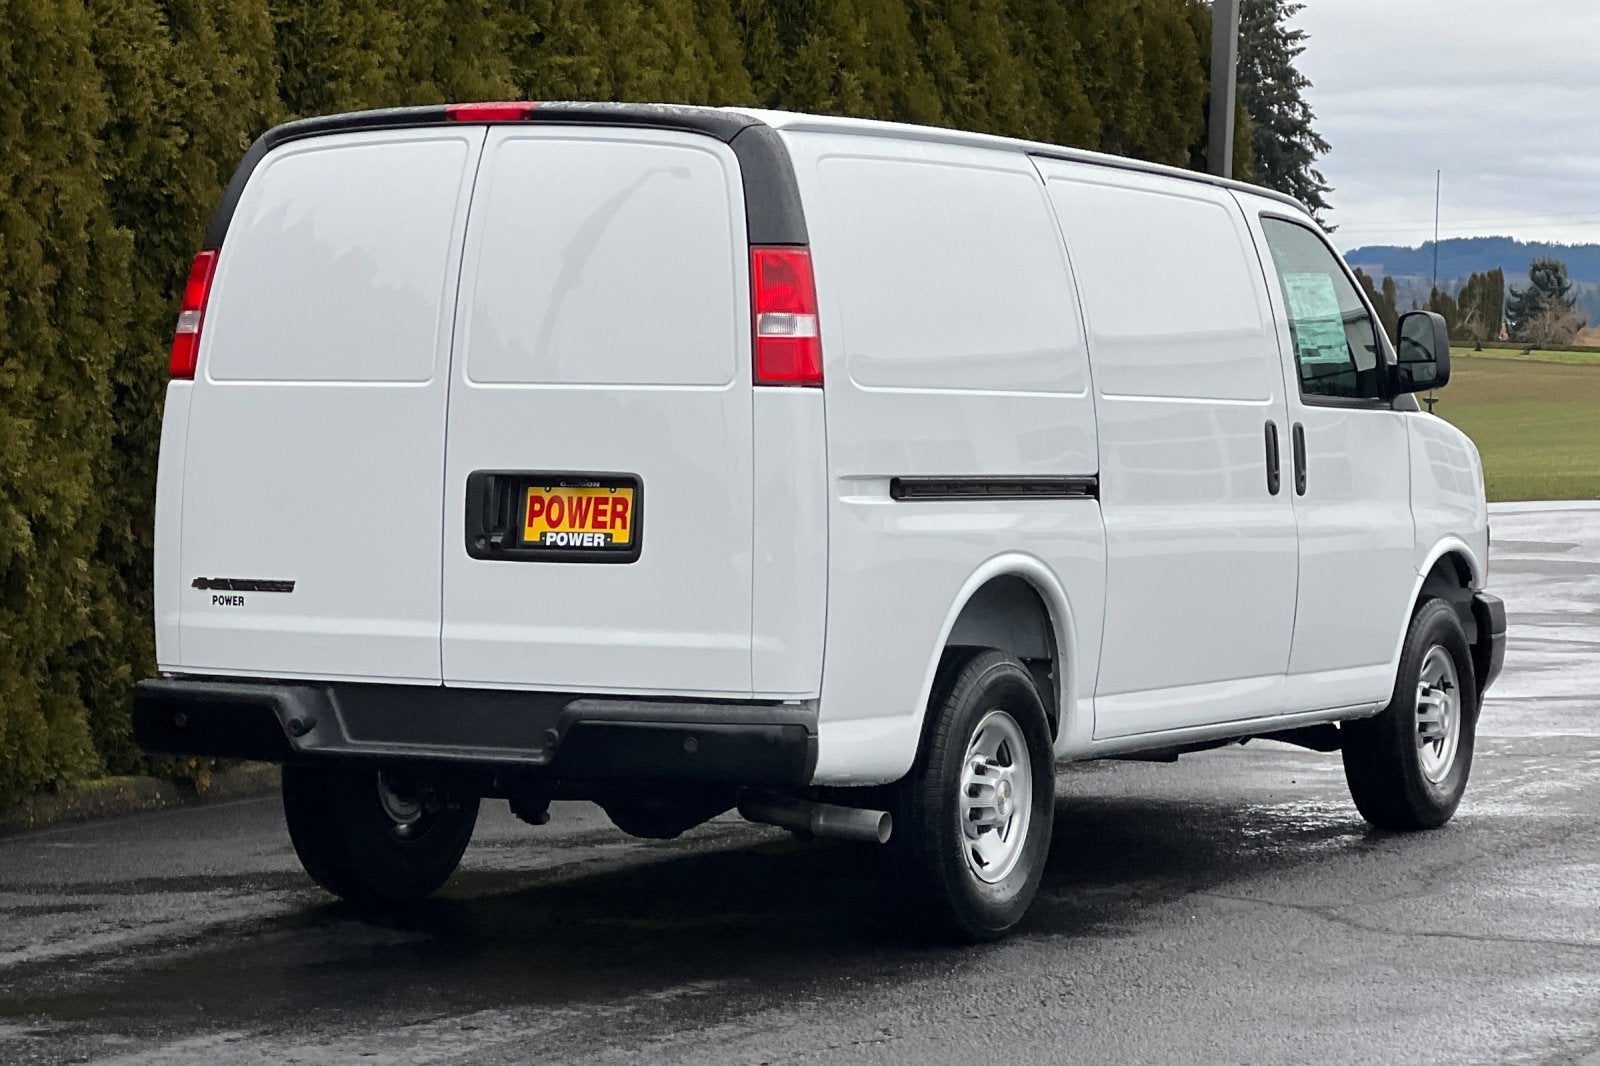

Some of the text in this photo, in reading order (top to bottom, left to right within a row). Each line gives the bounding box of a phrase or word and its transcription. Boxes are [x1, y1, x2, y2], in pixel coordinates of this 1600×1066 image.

[527, 495, 629, 530] POWER
[545, 532, 605, 547] POWER
[212, 595, 245, 607] POWER
